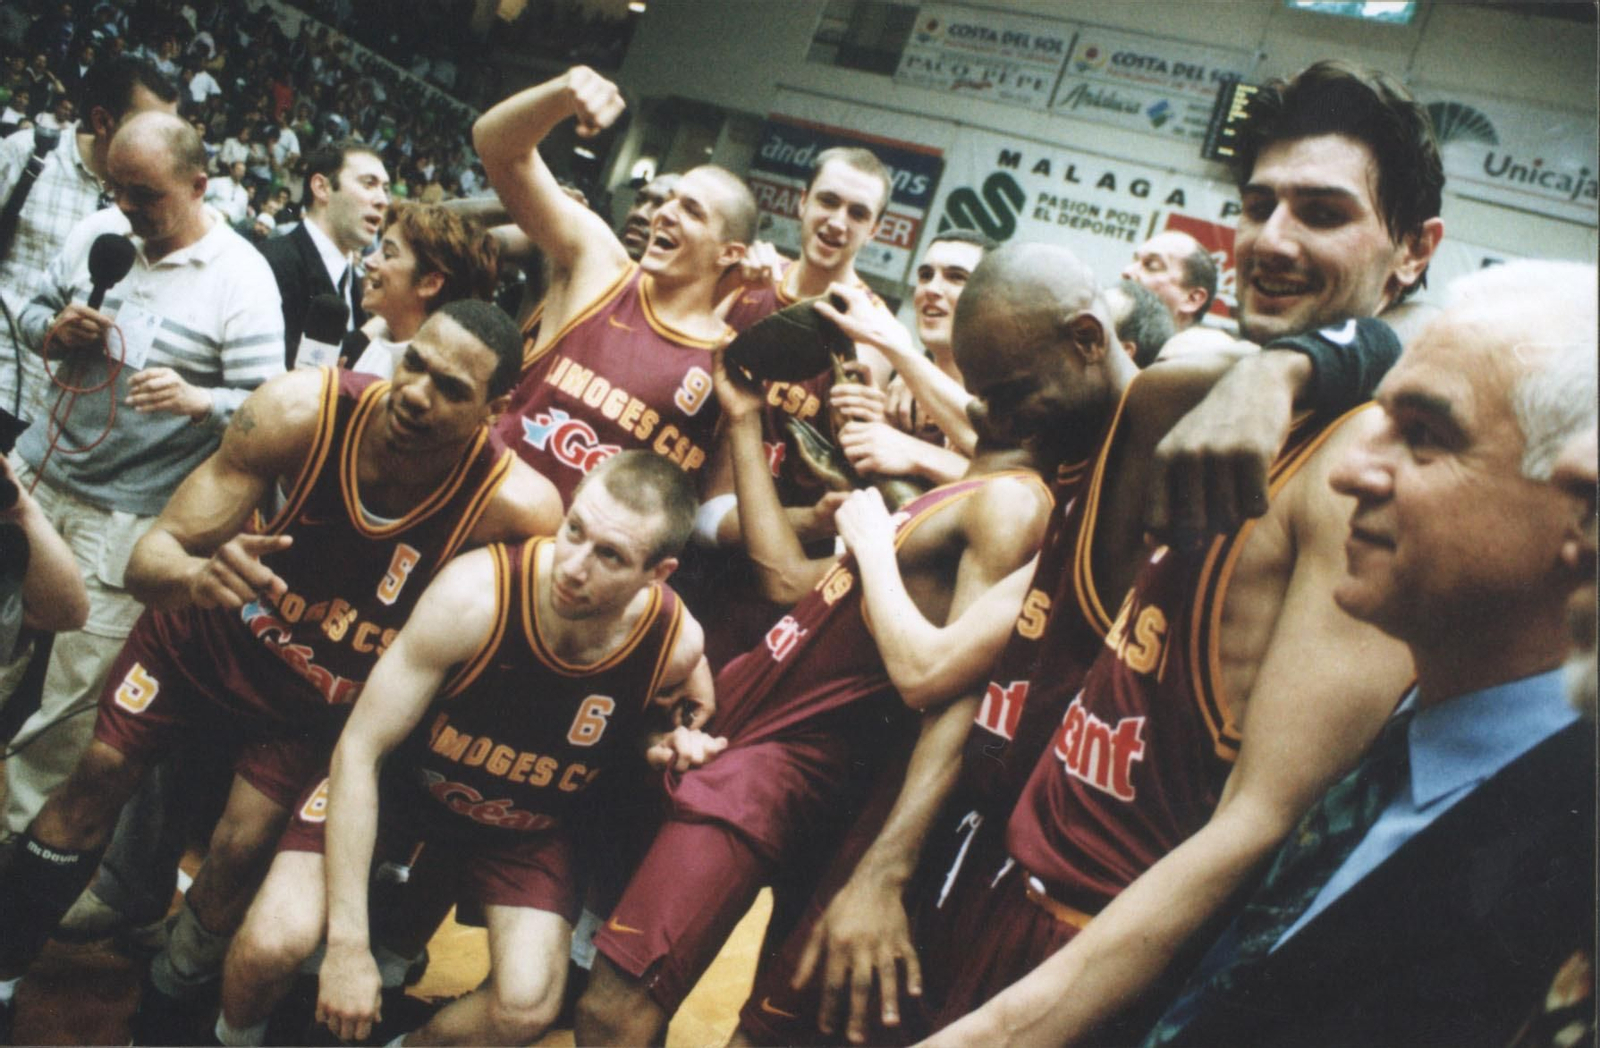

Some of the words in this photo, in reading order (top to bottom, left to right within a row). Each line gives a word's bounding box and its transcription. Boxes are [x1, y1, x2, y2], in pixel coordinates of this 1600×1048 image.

[947, 23, 998, 42] COSTA
[1002, 31, 1030, 48] DEL
[1034, 37, 1063, 53] SOL
[1111, 51, 1168, 73] COSTA
[1171, 62, 1204, 80] DEL
[997, 149, 1186, 207] MALAGA
[1033, 207, 1052, 222] EL
[1057, 213, 1138, 242] DEPORTE
[1037, 193, 1100, 217] PASION
[1106, 209, 1142, 227] POR
[673, 365, 713, 417] 9
[767, 381, 821, 420] CSP
[653, 425, 706, 472] CSP
[376, 543, 422, 606] 5
[114, 662, 160, 714] 5
[566, 694, 616, 747] 6
